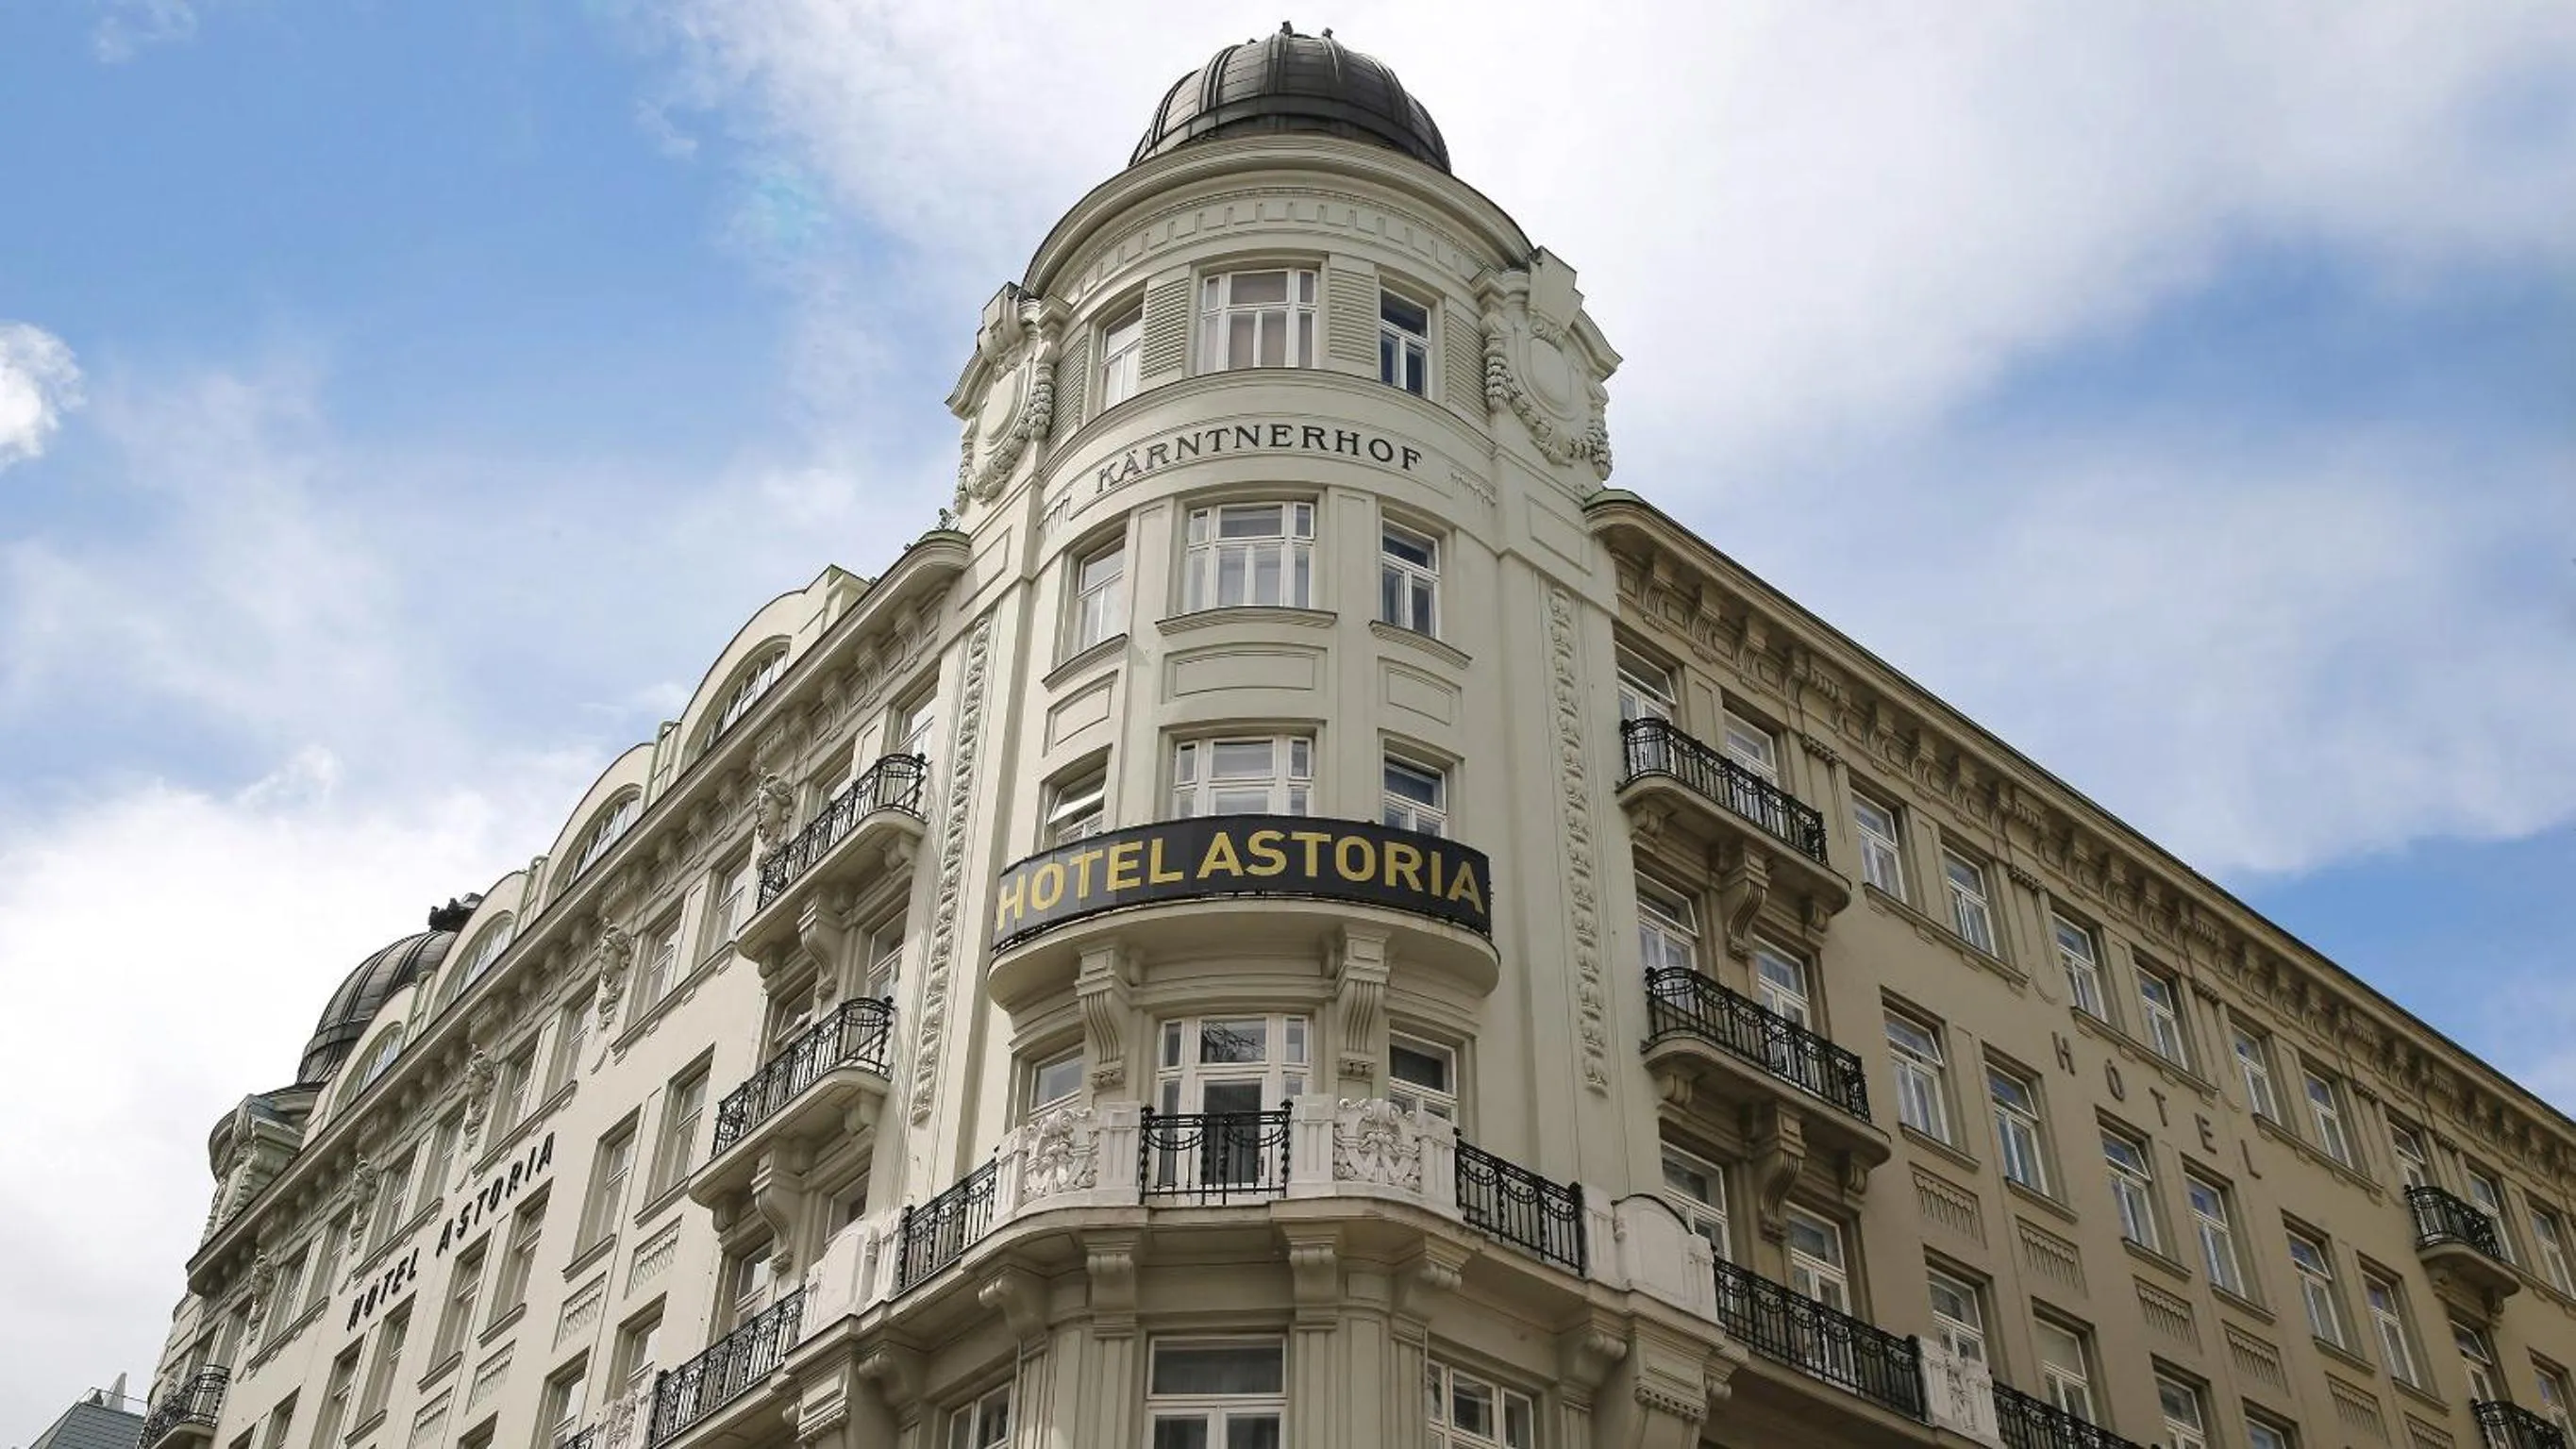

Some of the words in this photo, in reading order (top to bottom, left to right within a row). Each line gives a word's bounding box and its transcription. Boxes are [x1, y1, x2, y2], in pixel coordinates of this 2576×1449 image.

[1096, 424, 1422, 492] KÄRNTNERHOF
[996, 838, 1184, 929] HOTEL
[1196, 830, 1486, 915] ASTORIA
[436, 1131, 555, 1259] ASTORIA
